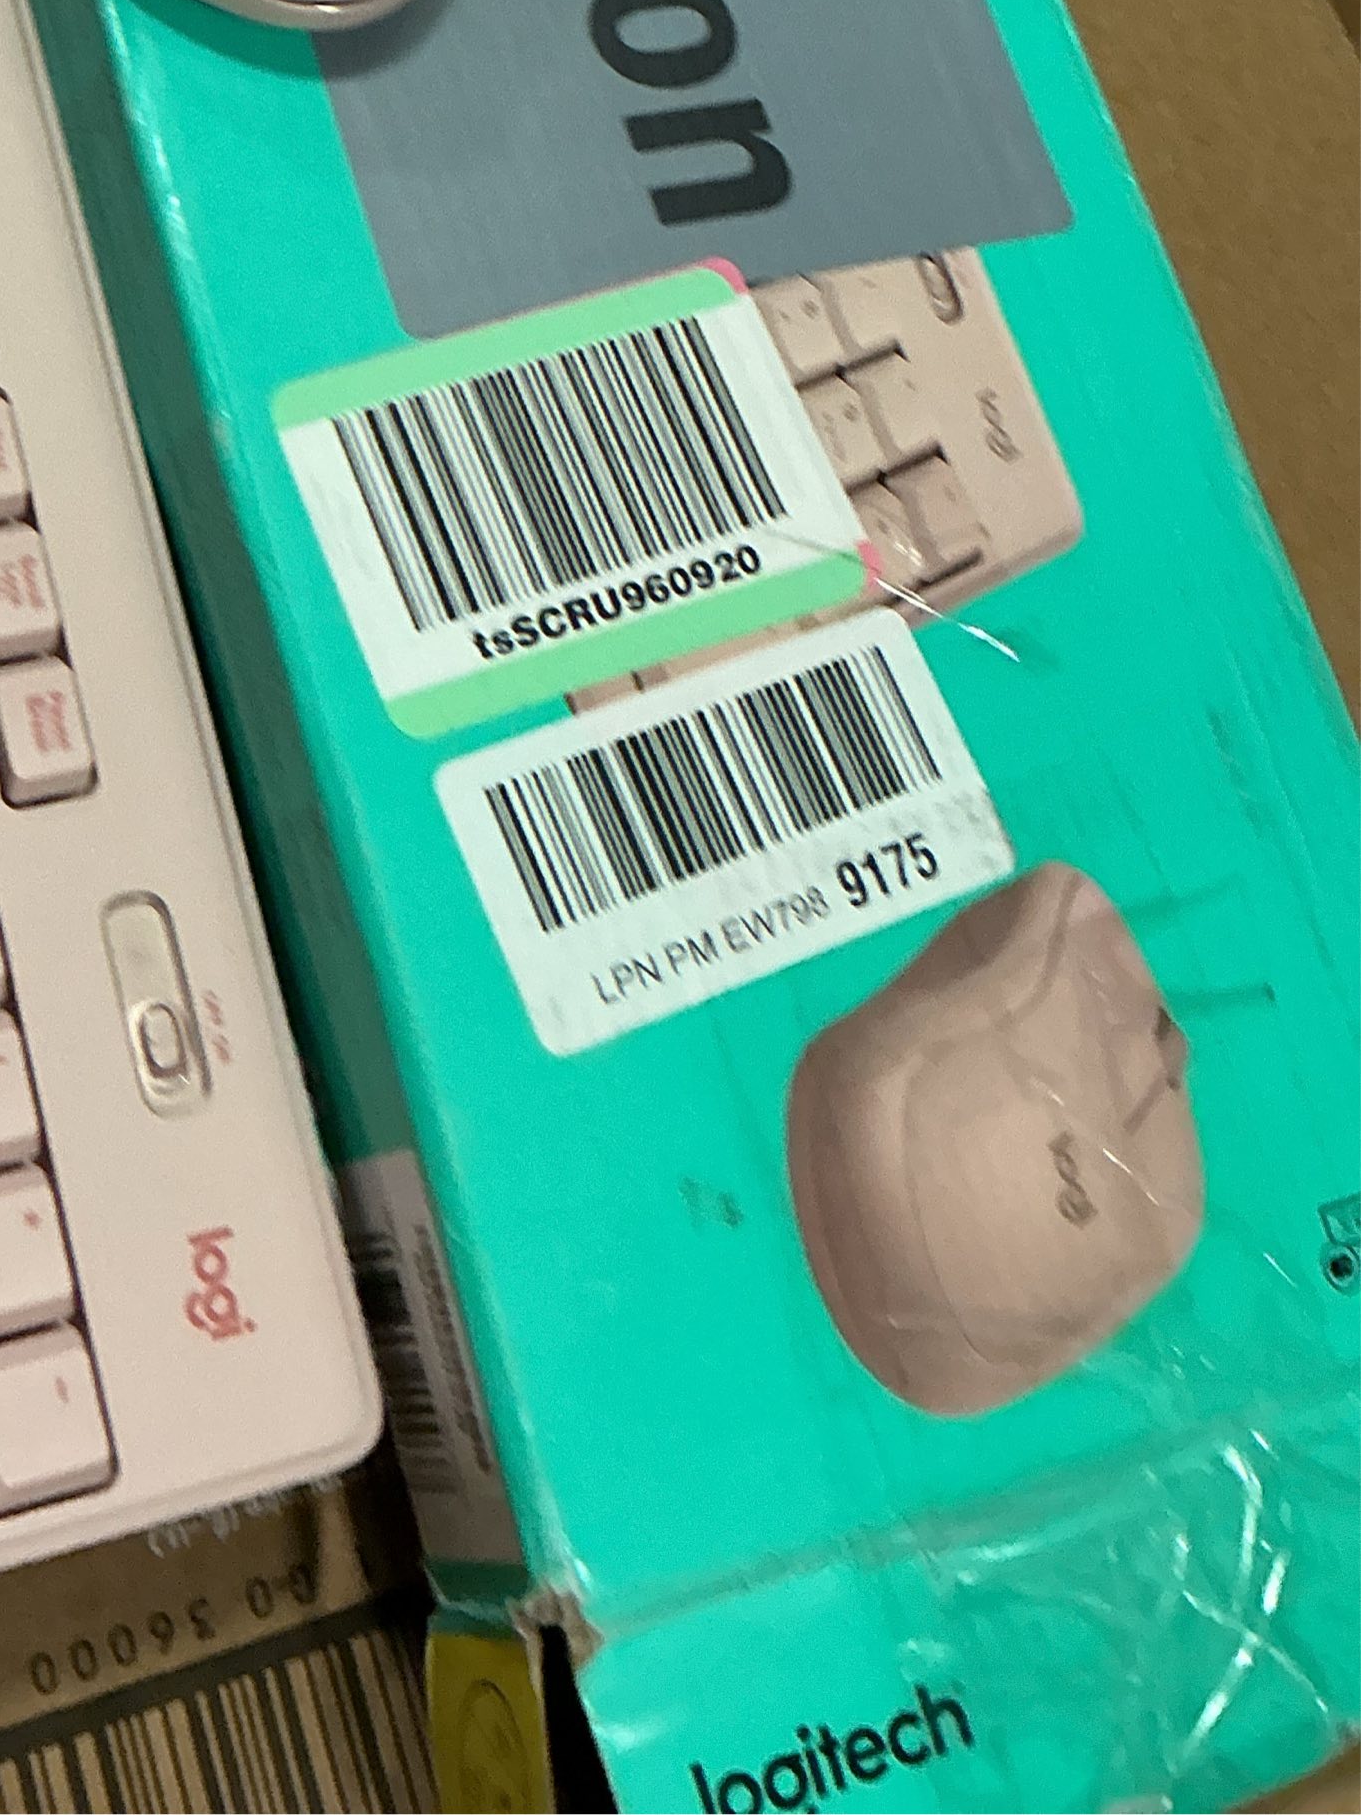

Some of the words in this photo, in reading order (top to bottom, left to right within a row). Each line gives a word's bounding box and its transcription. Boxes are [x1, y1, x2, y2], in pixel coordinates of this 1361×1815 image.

[471, 545, 762, 660] tsSCRU960920
[590, 952, 664, 1005] LPN
[663, 928, 722, 977] PM
[836, 832, 939, 908] 9175
[187, 1226, 256, 1341] logi
[27, 1596, 218, 1696] 36000
[690, 1682, 975, 1815] logitech
